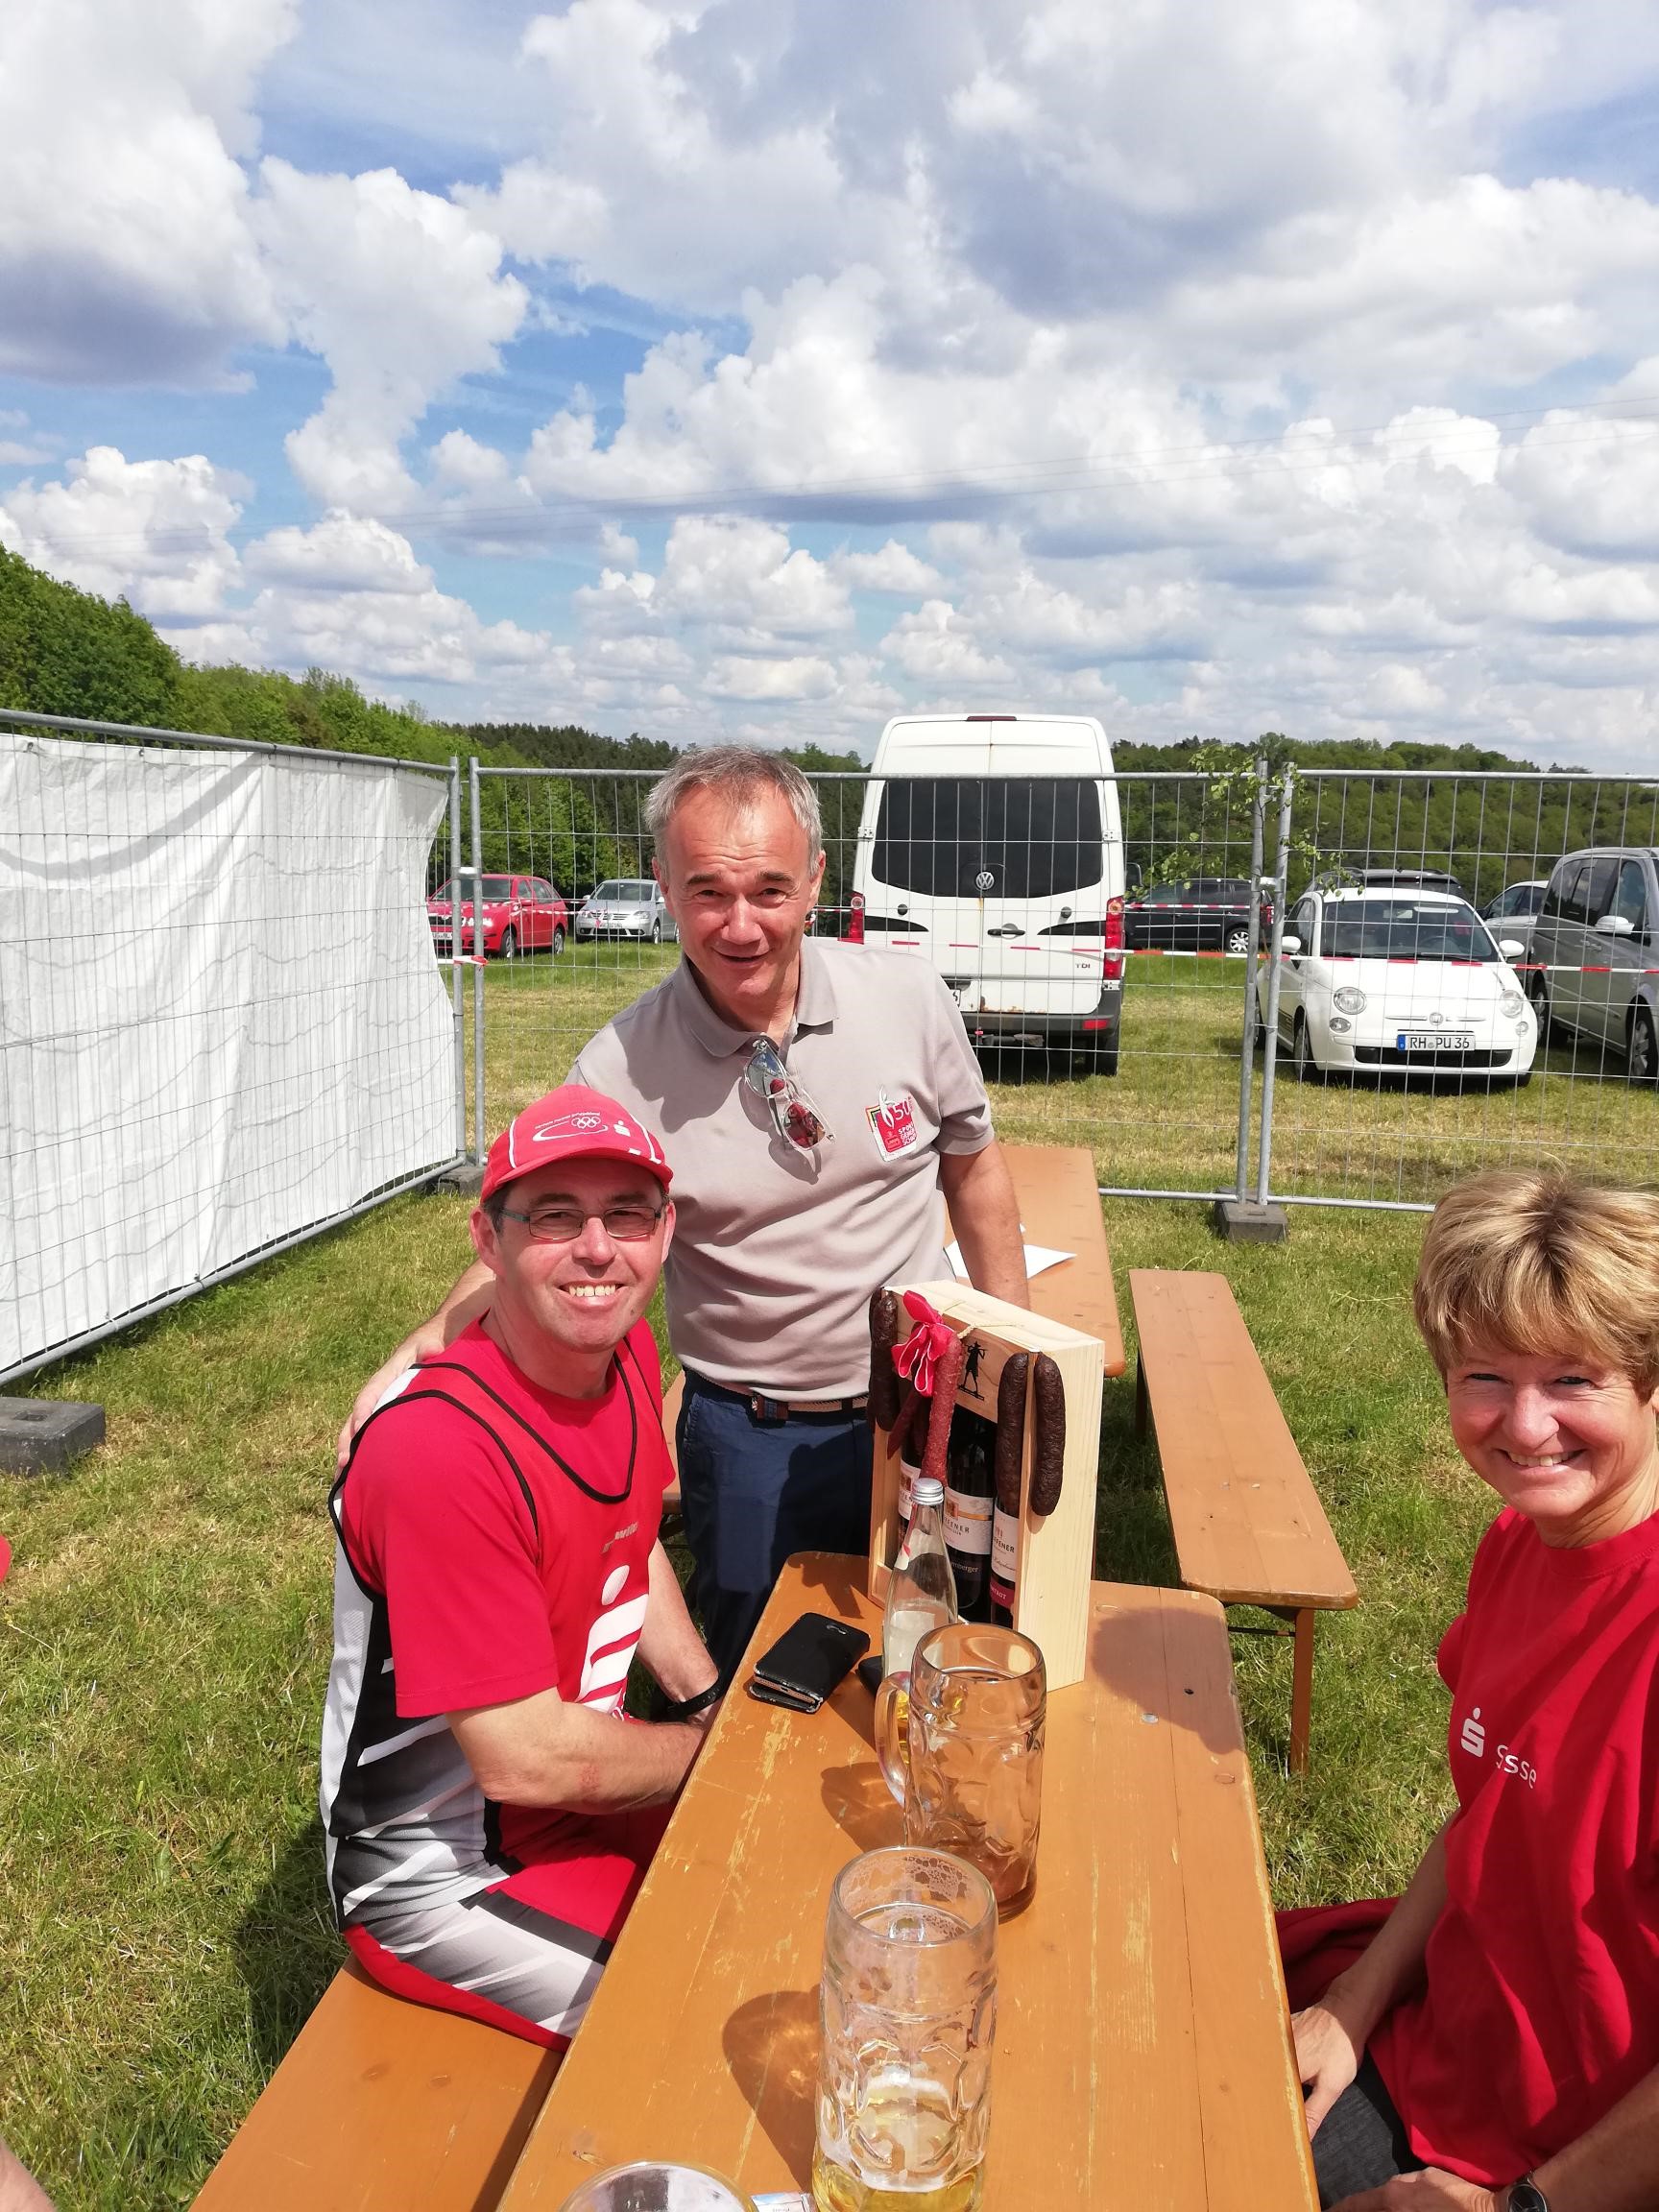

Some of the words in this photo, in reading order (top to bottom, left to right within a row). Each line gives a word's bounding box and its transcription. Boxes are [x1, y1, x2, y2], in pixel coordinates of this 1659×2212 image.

[1410, 1037, 1427, 1048] RH
[1435, 1037, 1452, 1048] PU
[1455, 1037, 1470, 1048] 36
